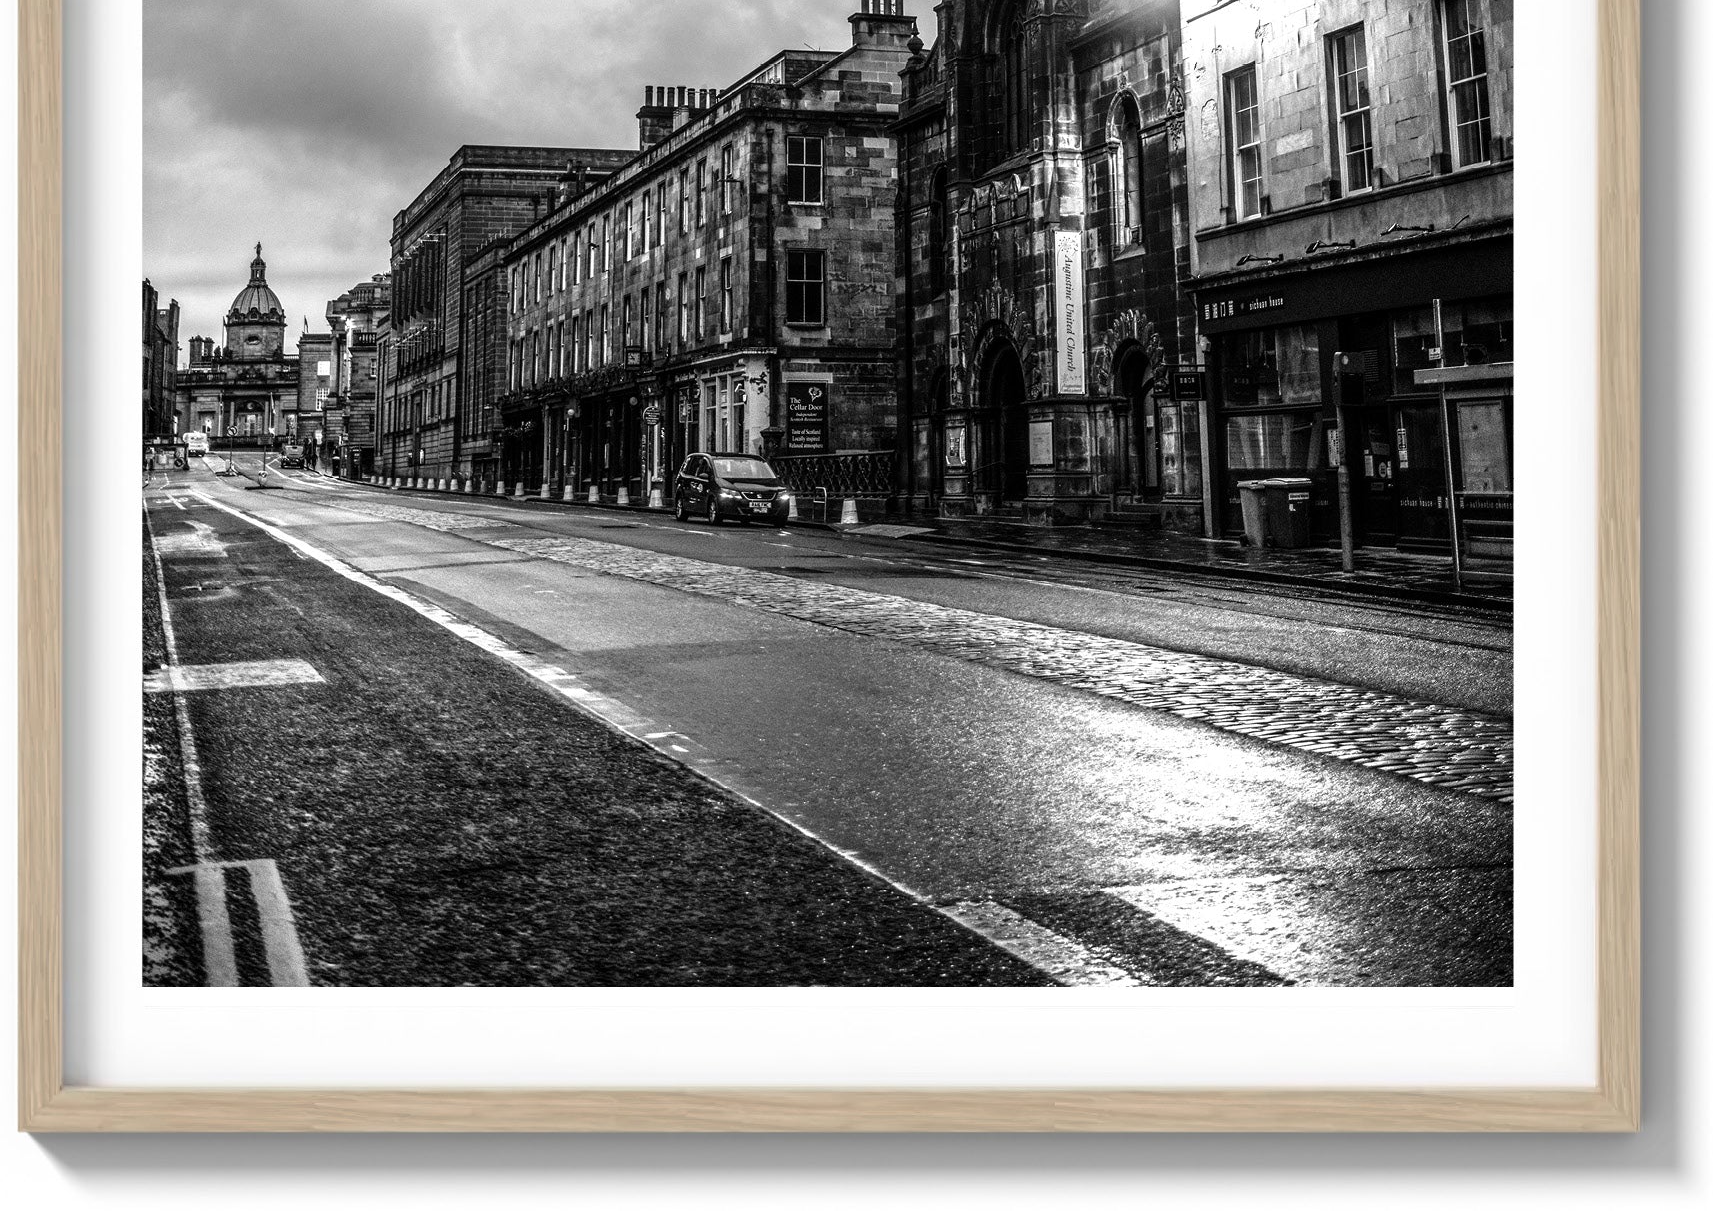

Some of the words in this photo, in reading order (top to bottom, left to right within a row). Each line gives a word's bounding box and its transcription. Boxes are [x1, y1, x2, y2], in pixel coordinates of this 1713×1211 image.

[1062, 254, 1074, 301] Augustine
[1065, 303, 1076, 336] United
[1249, 298, 1268, 311] sichuan
[1268, 295, 1284, 307] house
[1066, 337, 1077, 372] Church
[789, 403, 807, 411] Cellar
[808, 403, 823, 411] Door
